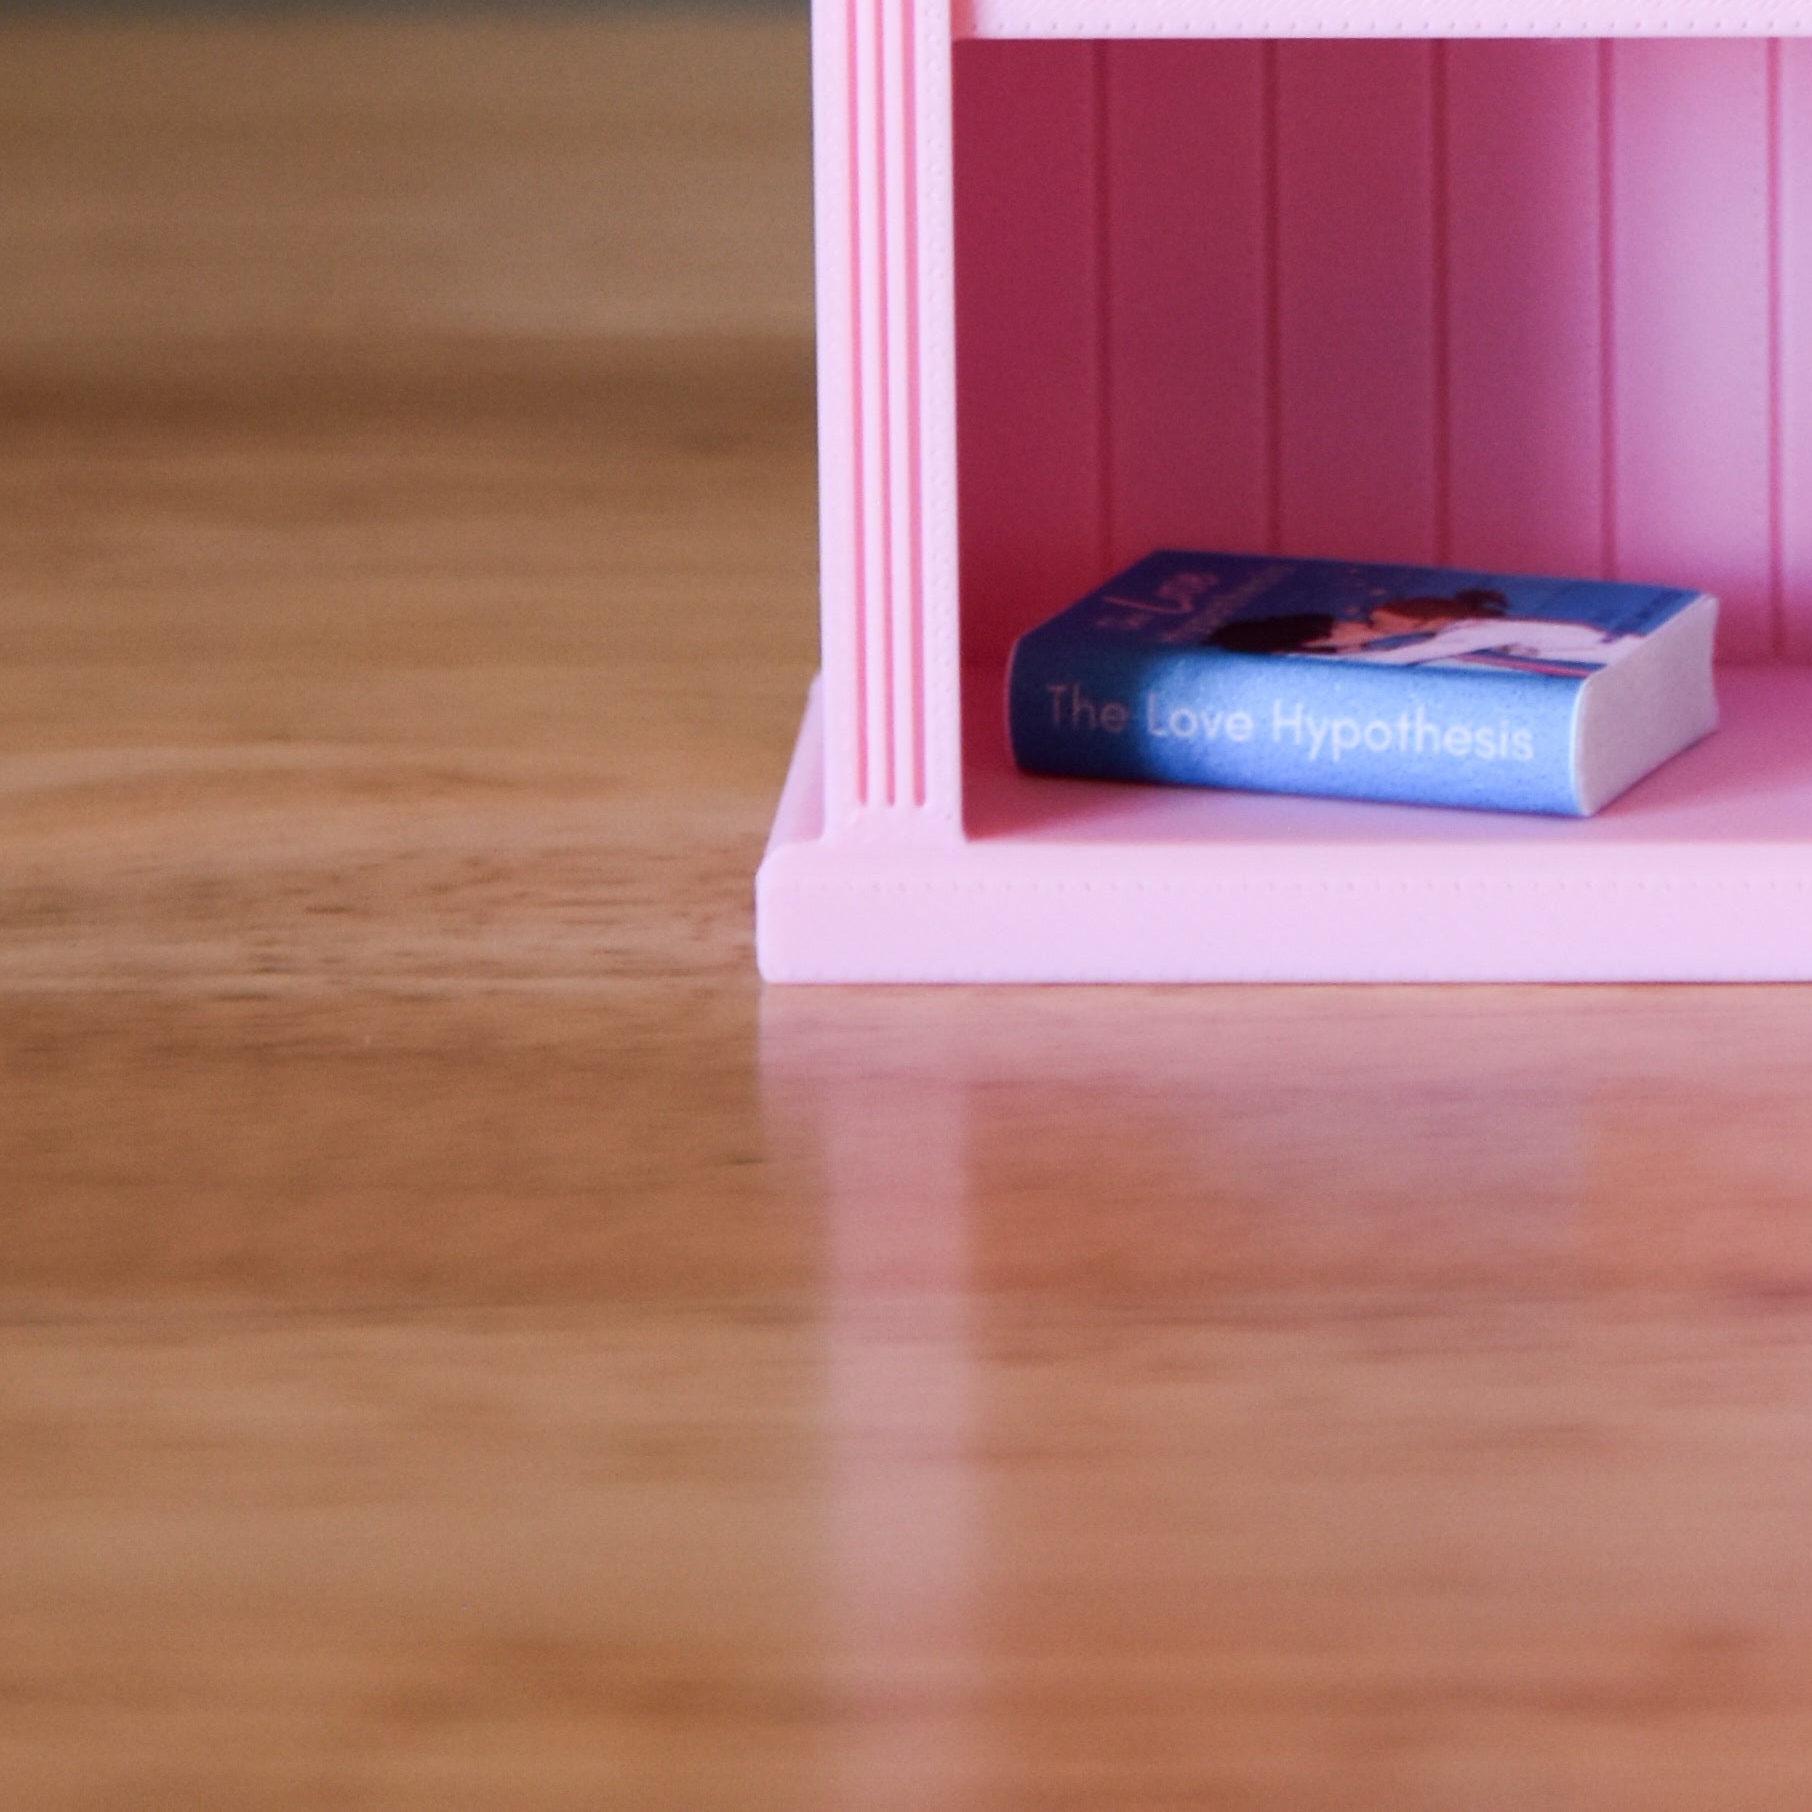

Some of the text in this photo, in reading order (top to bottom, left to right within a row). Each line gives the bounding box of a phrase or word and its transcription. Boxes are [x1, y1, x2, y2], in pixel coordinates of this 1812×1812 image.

[1046, 685, 1535, 763] The Love Hypothesis
